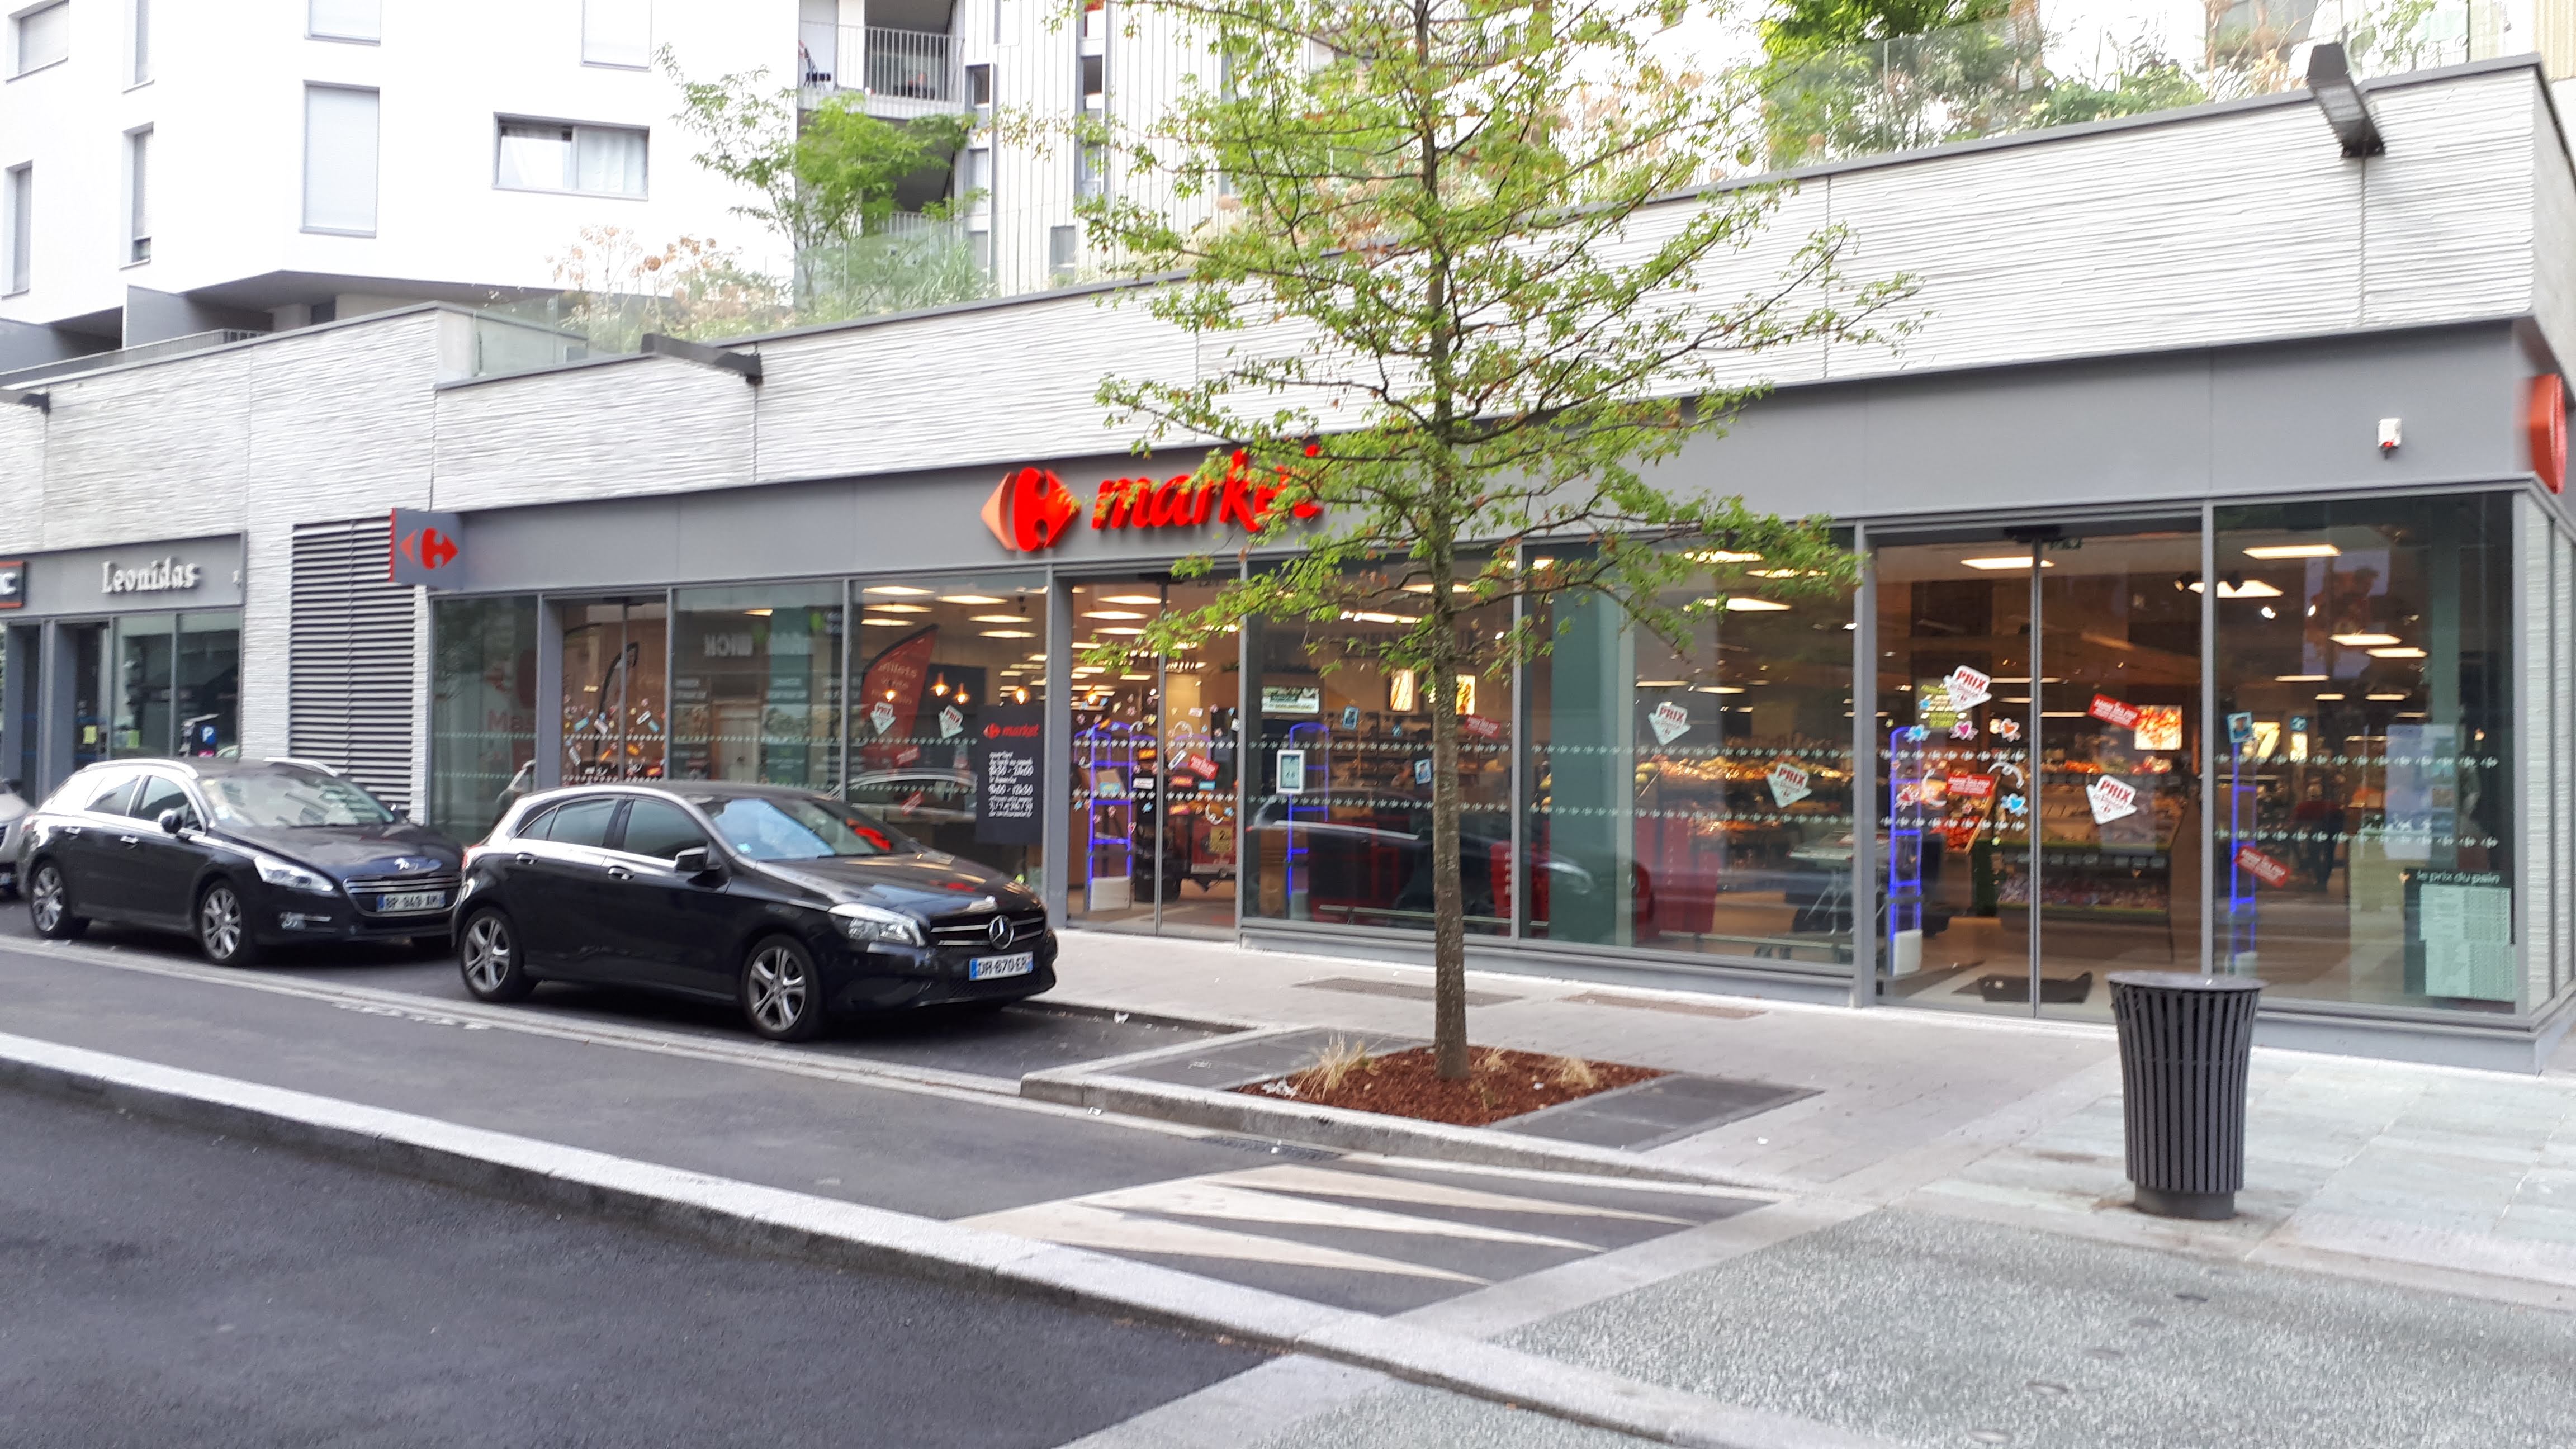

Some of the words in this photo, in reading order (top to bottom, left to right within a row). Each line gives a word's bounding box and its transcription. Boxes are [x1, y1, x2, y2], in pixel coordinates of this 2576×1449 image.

[101, 556, 200, 593] Leonidas
[1956, 670, 1986, 691] PRIX
[1659, 706, 1684, 722] PRIX
[1002, 723, 1040, 737] market
[1778, 768, 1806, 786] PRIX
[2100, 780, 2132, 803] PRIX
[2430, 870, 2453, 883] prix
[2454, 871, 2471, 883] du
[2471, 872, 2501, 884] pain
